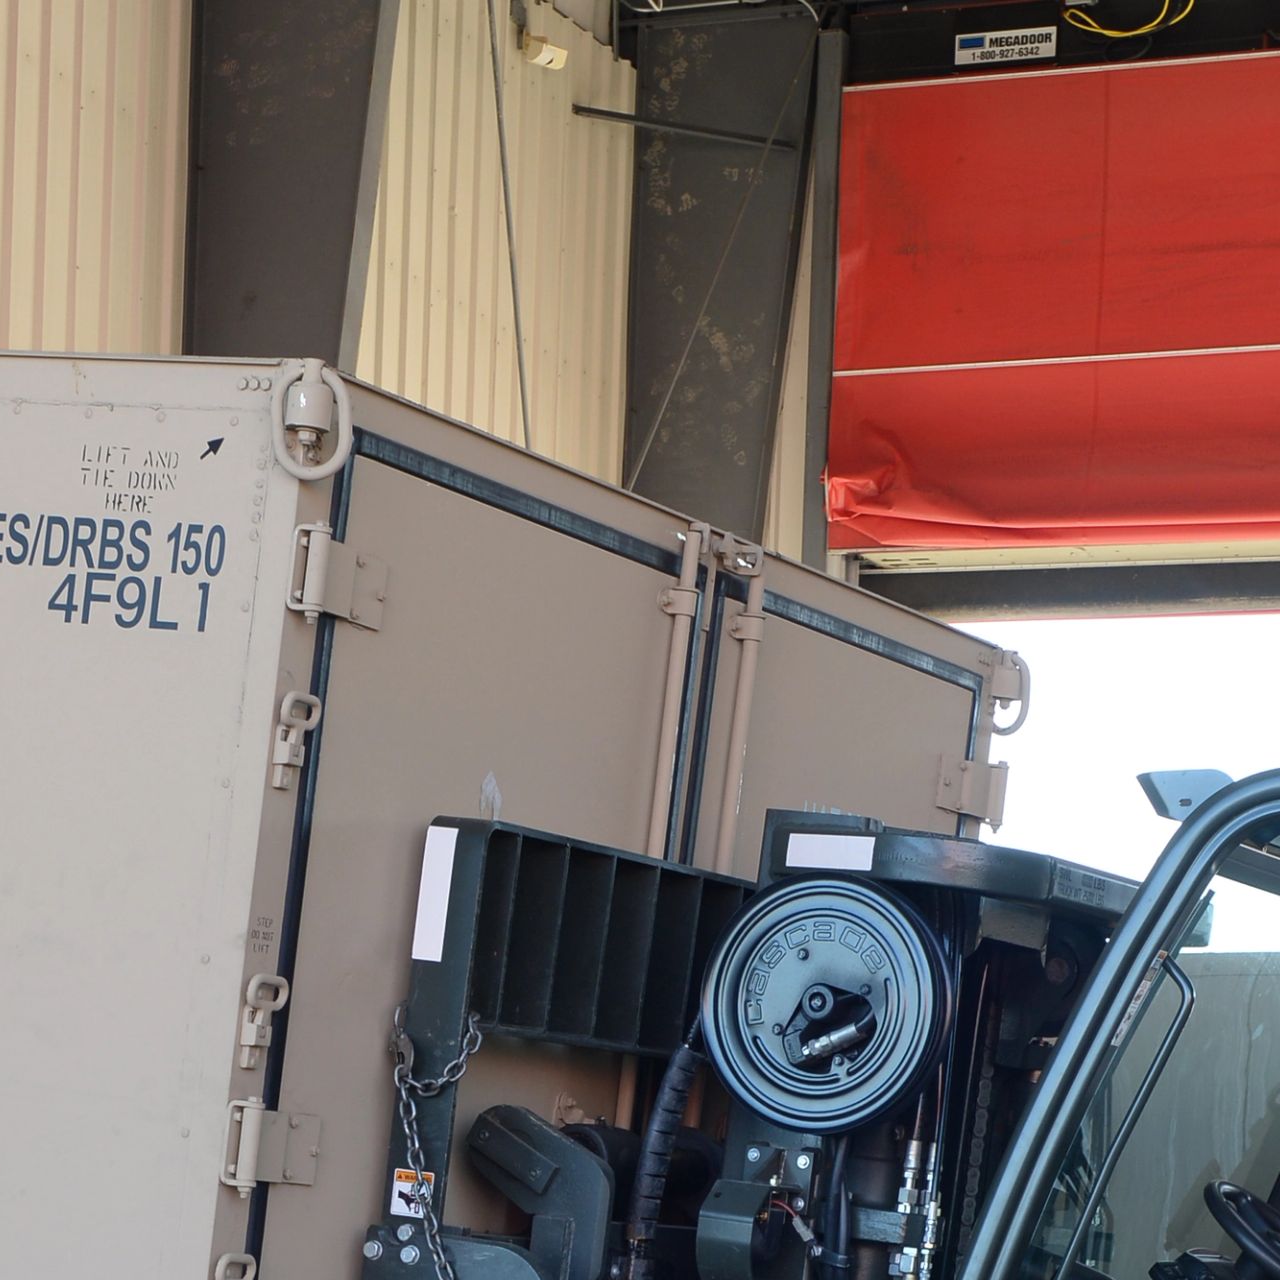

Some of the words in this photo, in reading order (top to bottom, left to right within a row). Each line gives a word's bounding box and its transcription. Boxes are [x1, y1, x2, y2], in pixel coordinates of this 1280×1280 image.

[988, 32, 1052, 48] MEGADOOR
[971, 46, 1040, 61] 1-800-927-6342
[82, 444, 131, 465] LIFT
[143, 450, 179, 469] AND
[81, 467, 115, 487] TIE
[127, 471, 176, 490] DOWN
[105, 492, 154, 513] HERE
[166, 522, 226, 577] 150
[745, 920, 886, 1025] cascade
